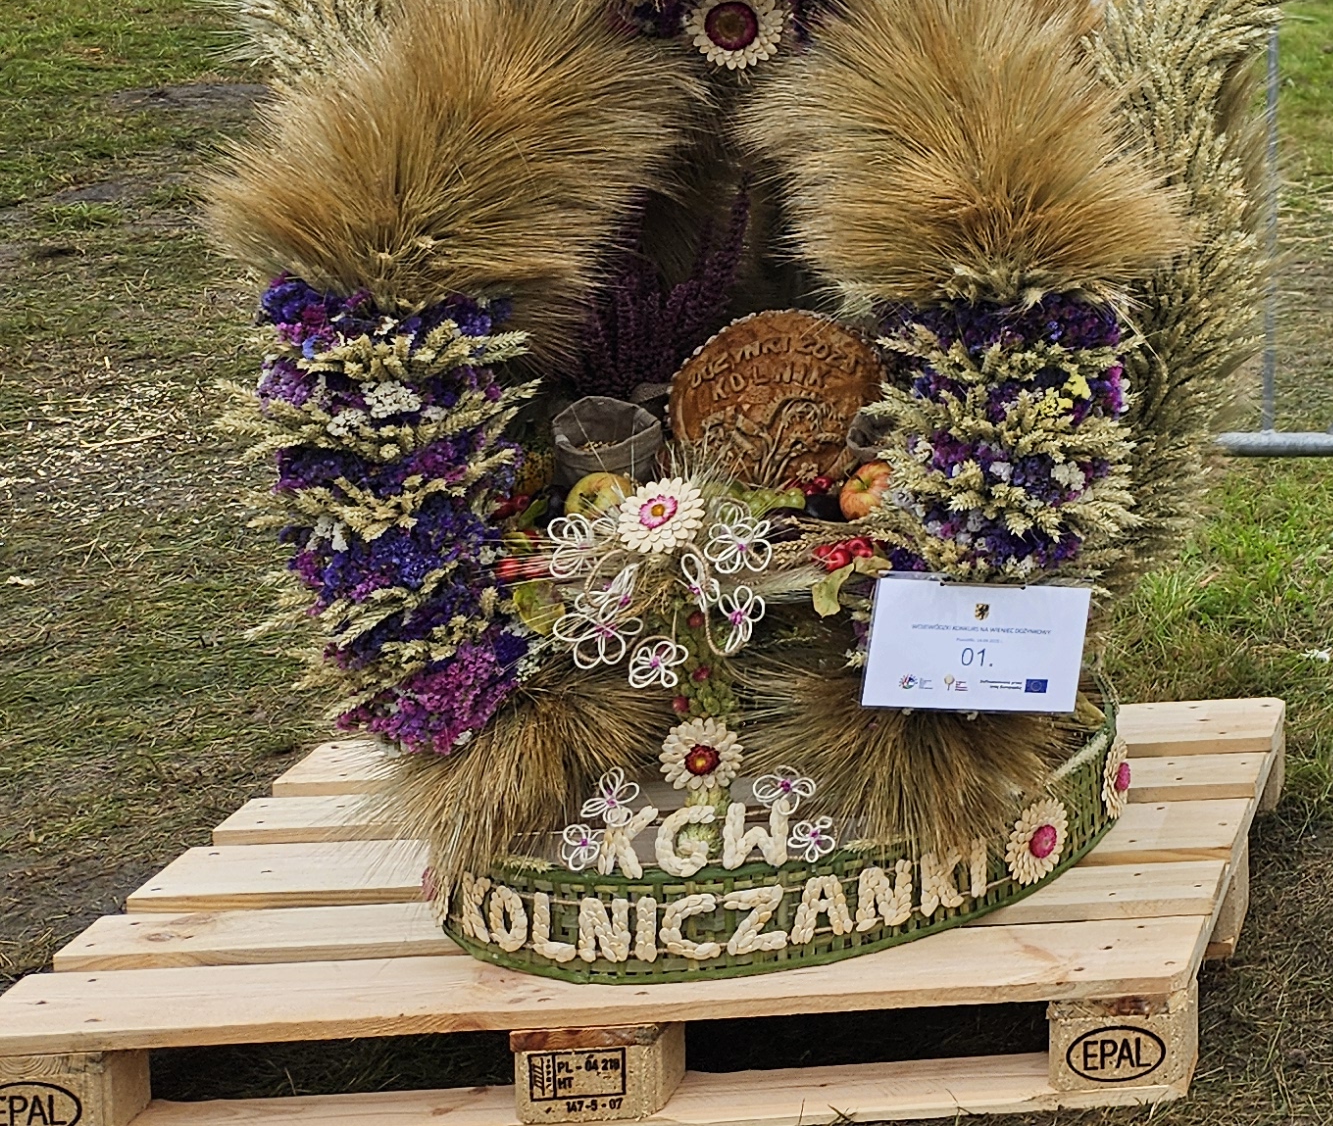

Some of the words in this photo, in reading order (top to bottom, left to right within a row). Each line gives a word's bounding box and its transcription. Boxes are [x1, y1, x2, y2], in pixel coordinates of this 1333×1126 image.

[961, 647, 993, 667] 01.
[598, 799, 790, 879] KGW
[461, 836, 988, 963] KOLNICZANKI
[1082, 1036, 1152, 1071] EPAL
[557, 1077, 574, 1090] HT
